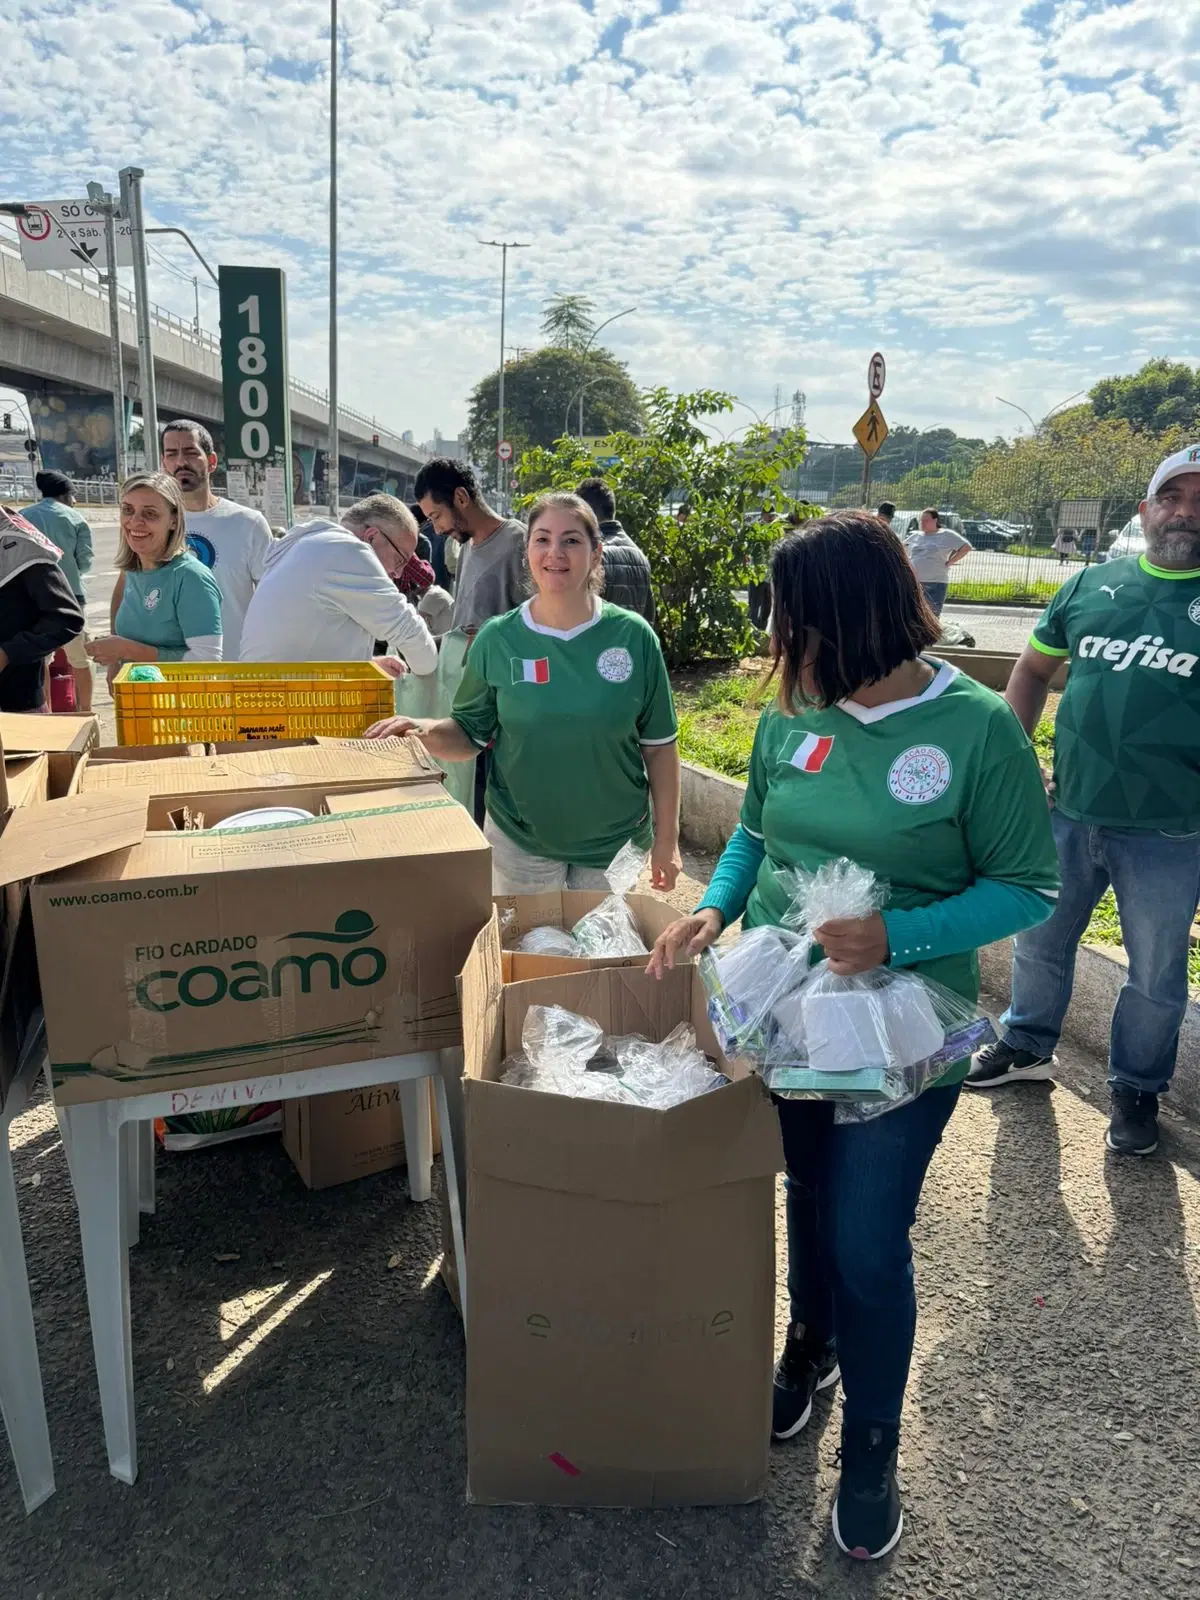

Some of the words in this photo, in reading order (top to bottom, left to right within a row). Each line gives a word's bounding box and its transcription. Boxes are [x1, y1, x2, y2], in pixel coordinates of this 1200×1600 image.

[61, 202, 80, 217] SÓ
[79, 227, 101, 238] Sáb.
[237, 295, 270, 459] 1800
[1078, 634, 1199, 678] crefisa
[927, 749, 948, 771] SOCIAL
[49, 884, 200, 908] www.coamo.com.br
[135, 943, 164, 963] FIO
[170, 934, 258, 959] CARDADO
[135, 946, 387, 1012] coamo
